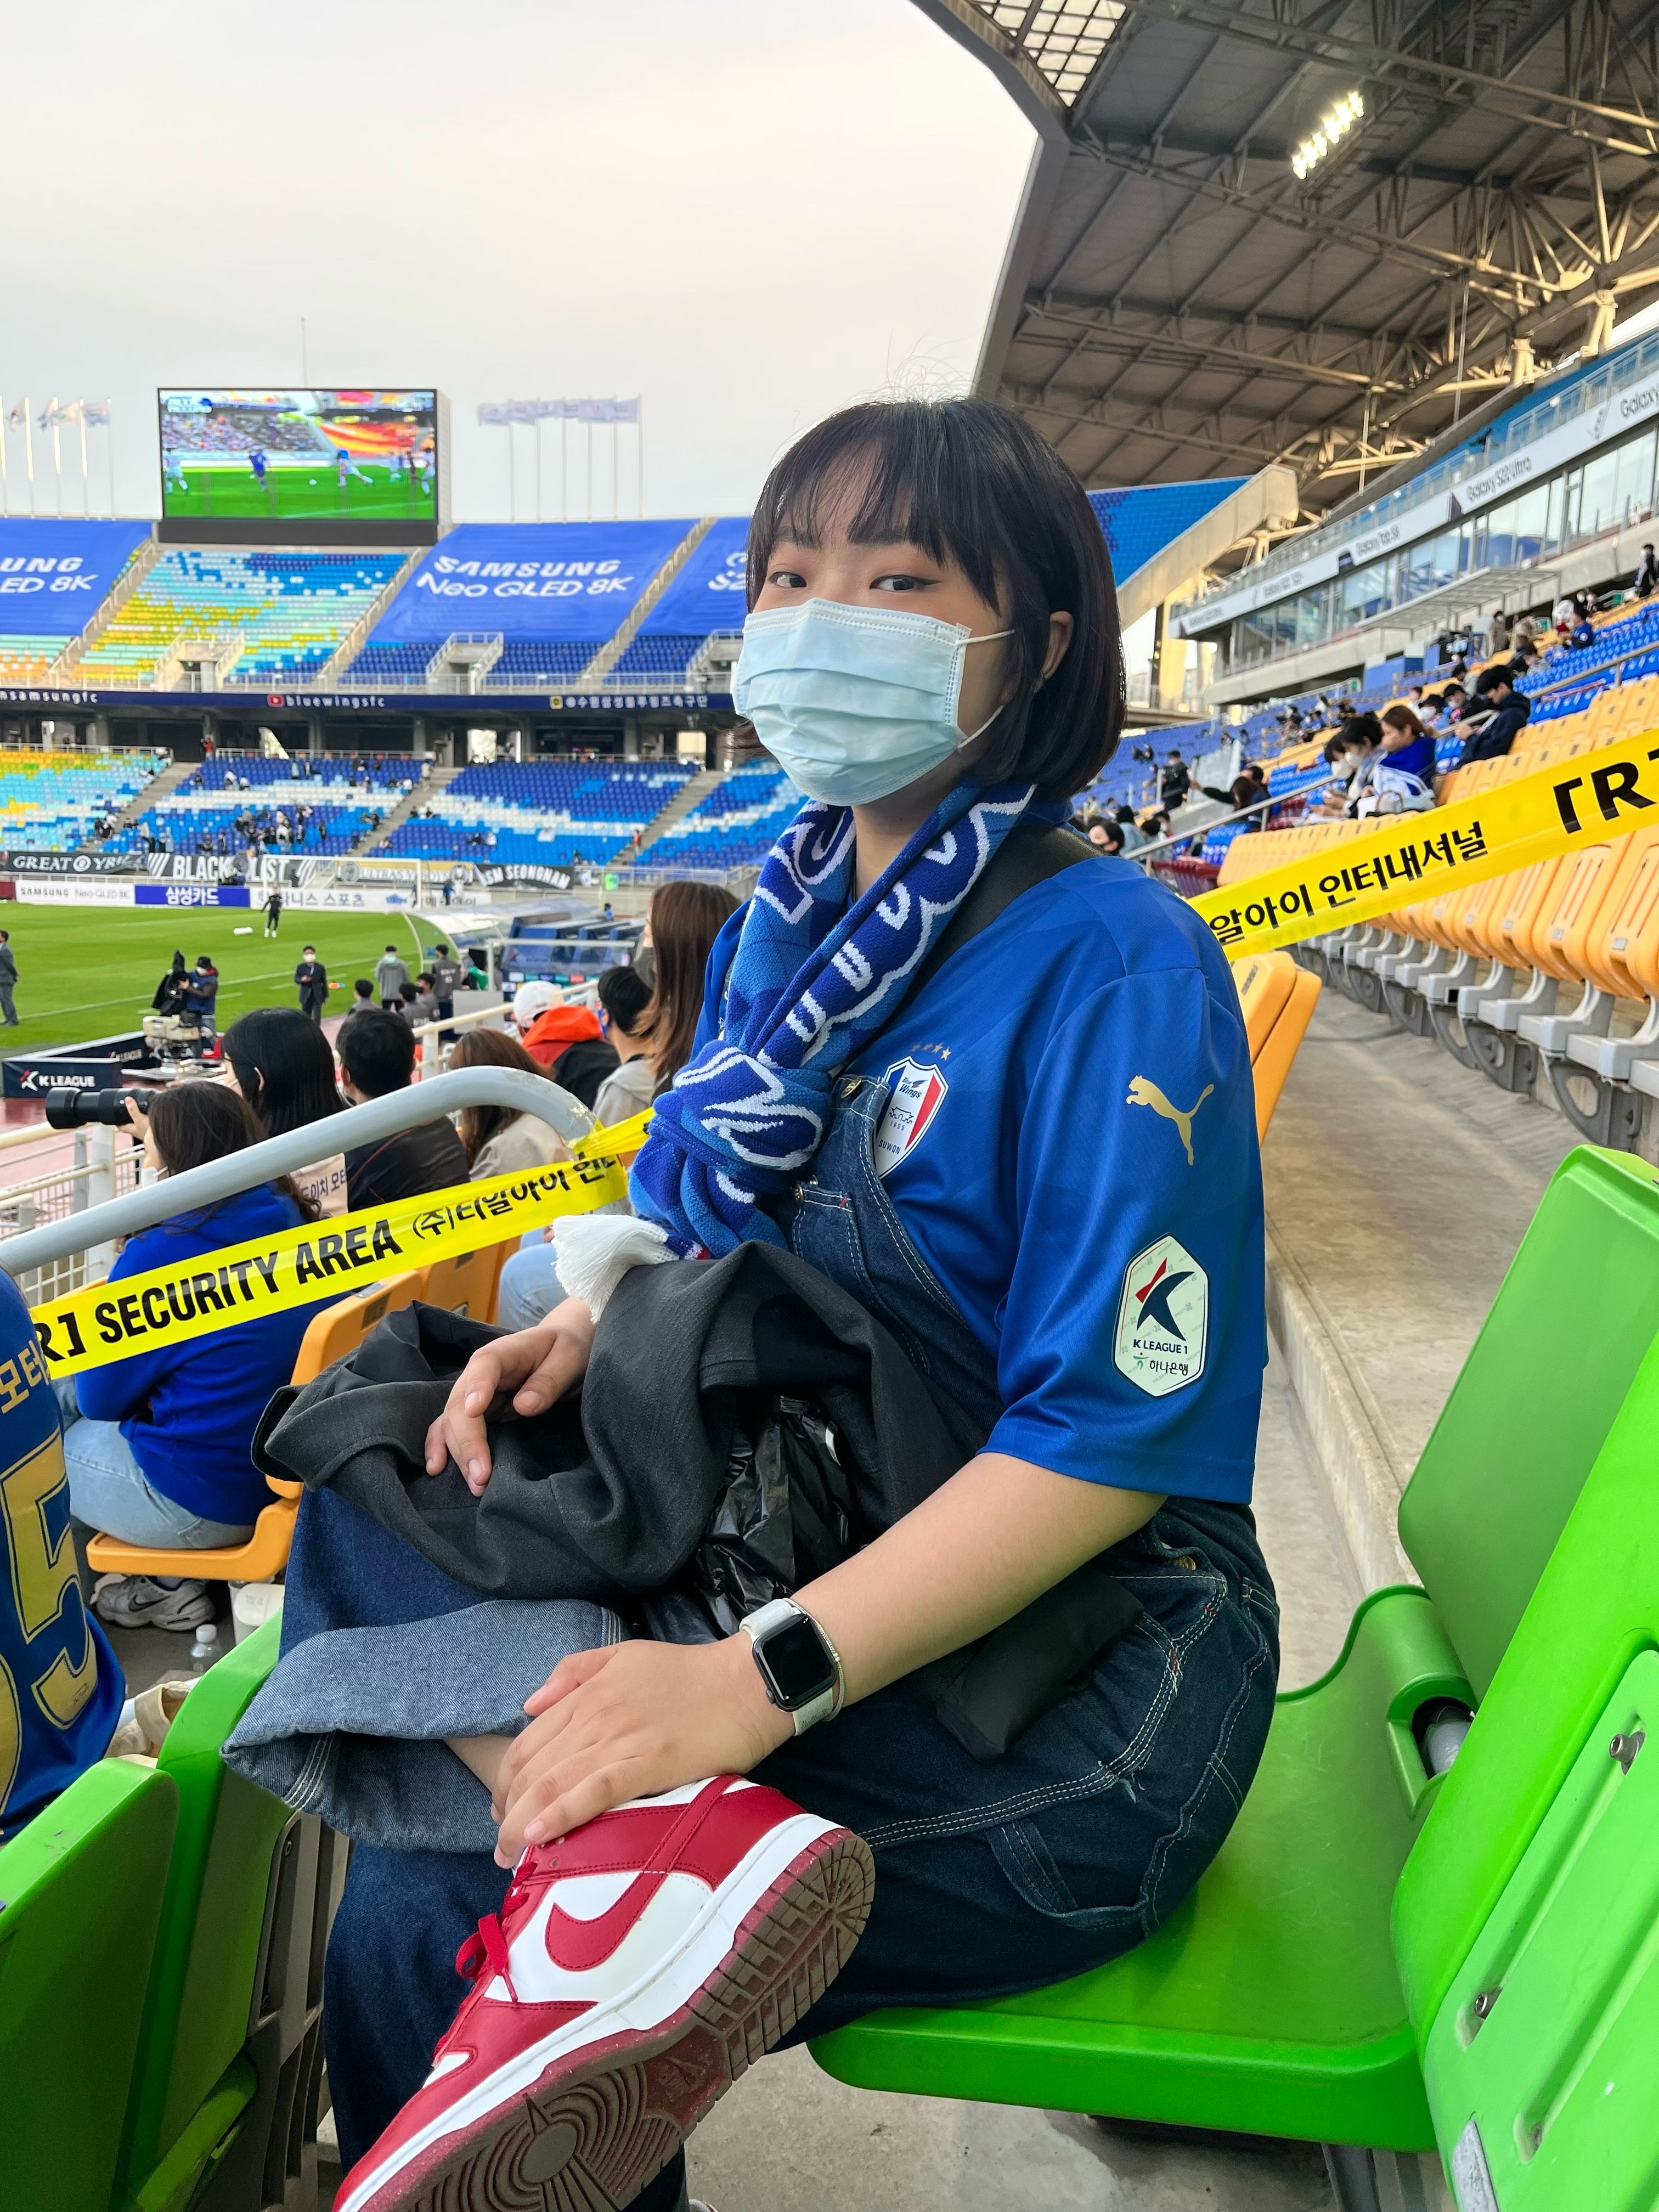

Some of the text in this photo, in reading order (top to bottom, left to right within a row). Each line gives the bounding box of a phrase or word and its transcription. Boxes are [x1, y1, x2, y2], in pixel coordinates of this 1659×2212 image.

[434, 556, 622, 578] SAMSUNG
[49, 574, 99, 592] 8K
[416, 572, 635, 597] Neo QLED 8K
[286, 695, 385, 709] bluewingsfc
[13, 855, 72, 871] GREAT
[173, 855, 290, 882] BLACK LIST
[1319, 821, 1488, 910] 인터내셔널
[505, 864, 571, 890] SEONGNAM
[20, 887, 69, 896] SAMSUNG
[75, 888, 94, 897] Neo
[95, 889, 117, 899] QLED
[166, 885, 220, 906] 삼성카드
[324, 892, 365, 907] 스포츠
[39, 1075, 95, 1087] K LEAGUE
[898, 1084, 922, 1098] Wings
[878, 1139, 901, 1155] SUWON
[95, 1251, 279, 1343] SECURITY
[295, 1219, 403, 1284] AREA
[1133, 1339, 1188, 1355] K LEAGUE 1
[1150, 1359, 1188, 1376] 하나은행
